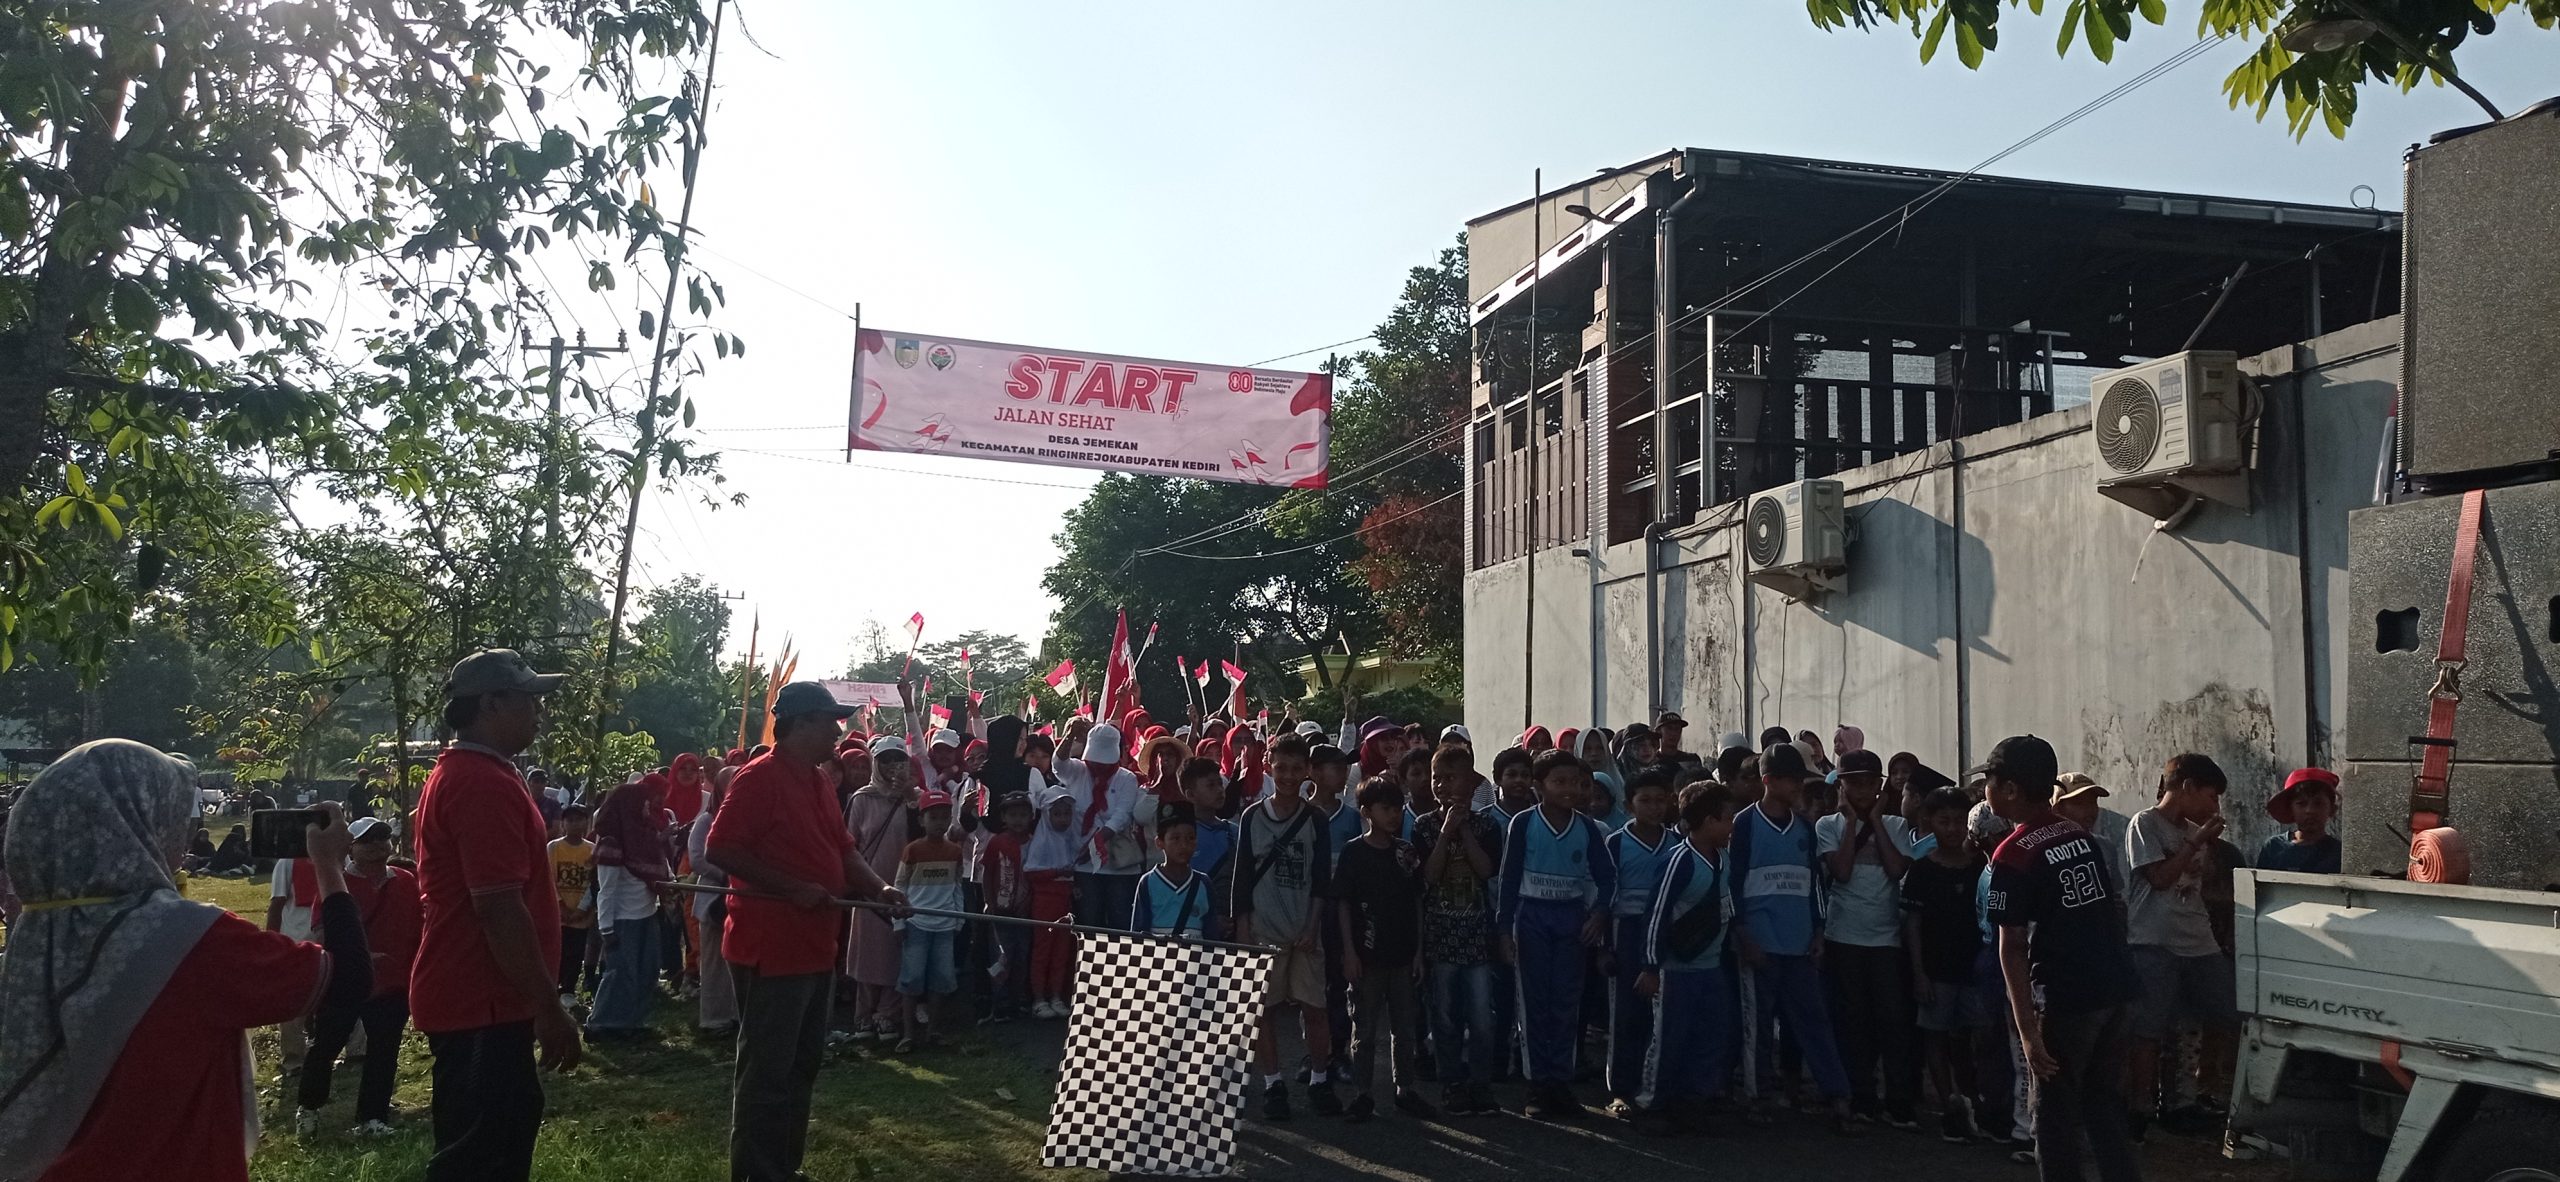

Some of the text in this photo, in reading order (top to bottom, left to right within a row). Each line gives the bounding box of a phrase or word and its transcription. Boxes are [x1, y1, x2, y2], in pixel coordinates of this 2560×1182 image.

[1004, 354, 1199, 416] START
[1228, 371, 1253, 393] 80
[994, 407, 1116, 431] JALAN SEHAT
[960, 440, 1221, 472] KECAMATAN RINGINREJOKABUPATEN KEDIRI
[1048, 435, 1139, 451] DESA JEMEKAN
[2045, 838, 2092, 865] ROOTLY
[2059, 861, 2106, 908] 321
[2270, 991, 2385, 1022] MEGA CARRY
